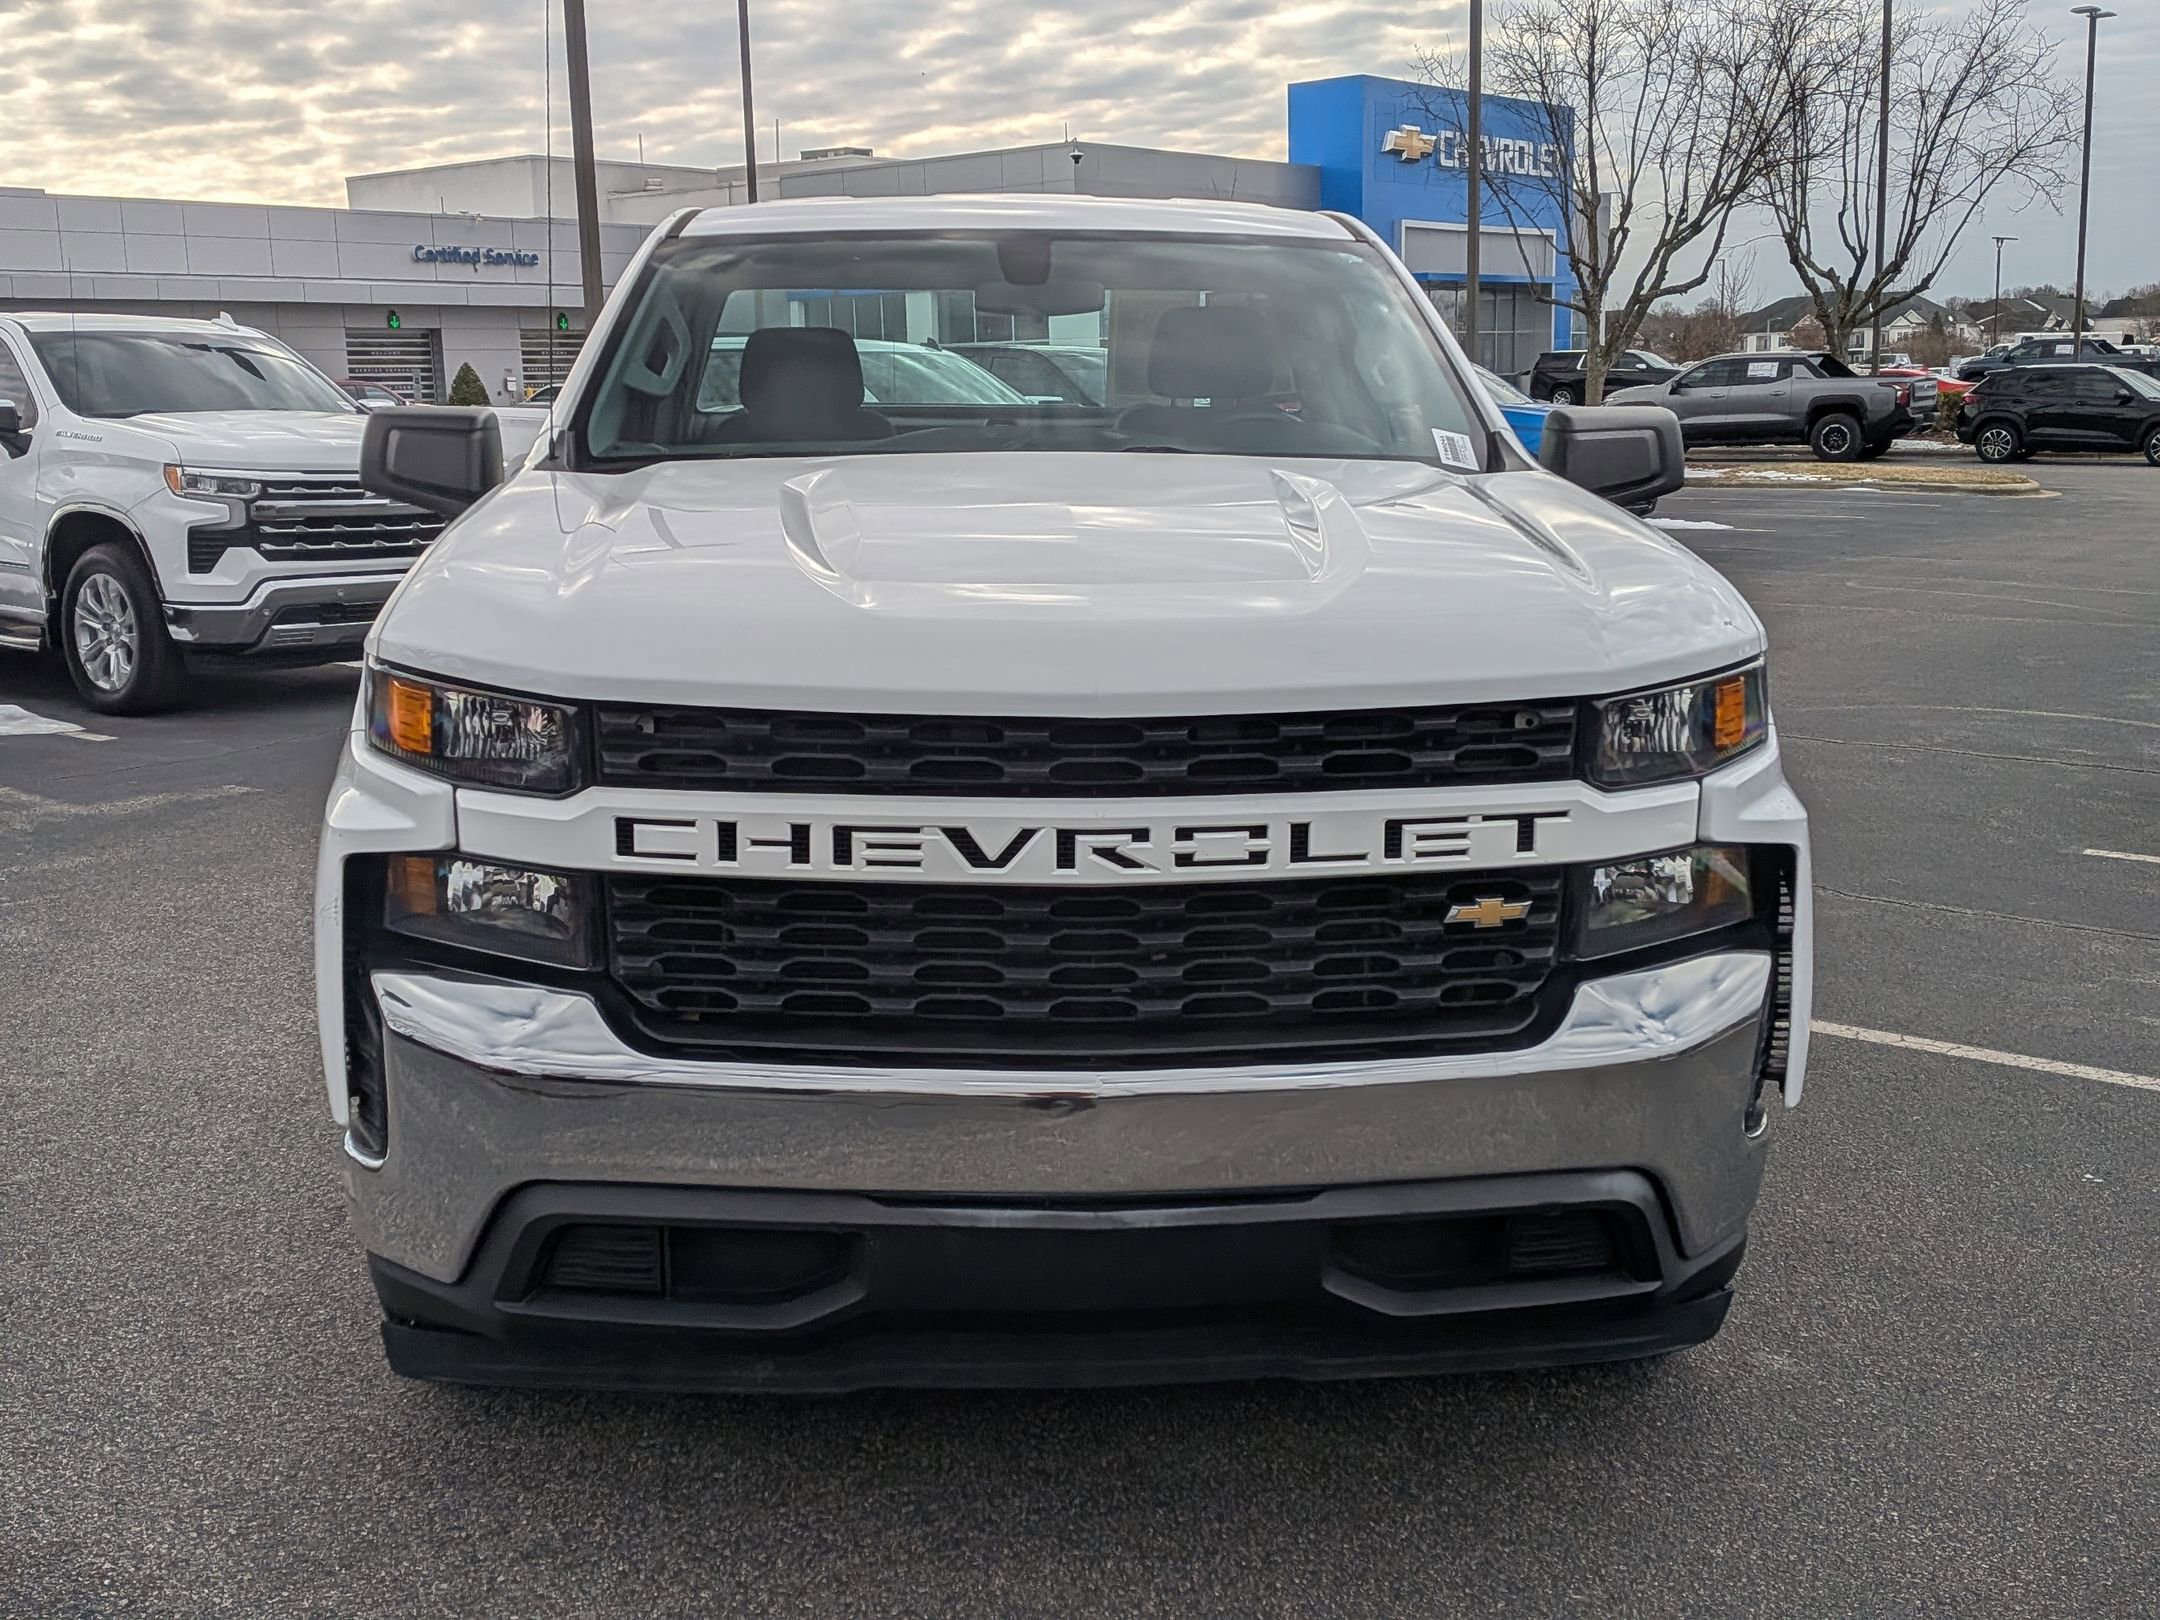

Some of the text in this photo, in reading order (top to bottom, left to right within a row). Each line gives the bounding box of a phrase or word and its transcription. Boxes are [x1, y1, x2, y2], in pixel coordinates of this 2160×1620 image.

[1439, 130, 1566, 177] CHVROLET
[413, 245, 539, 266] Certified Service
[613, 809, 1571, 875] CHEVROLET
